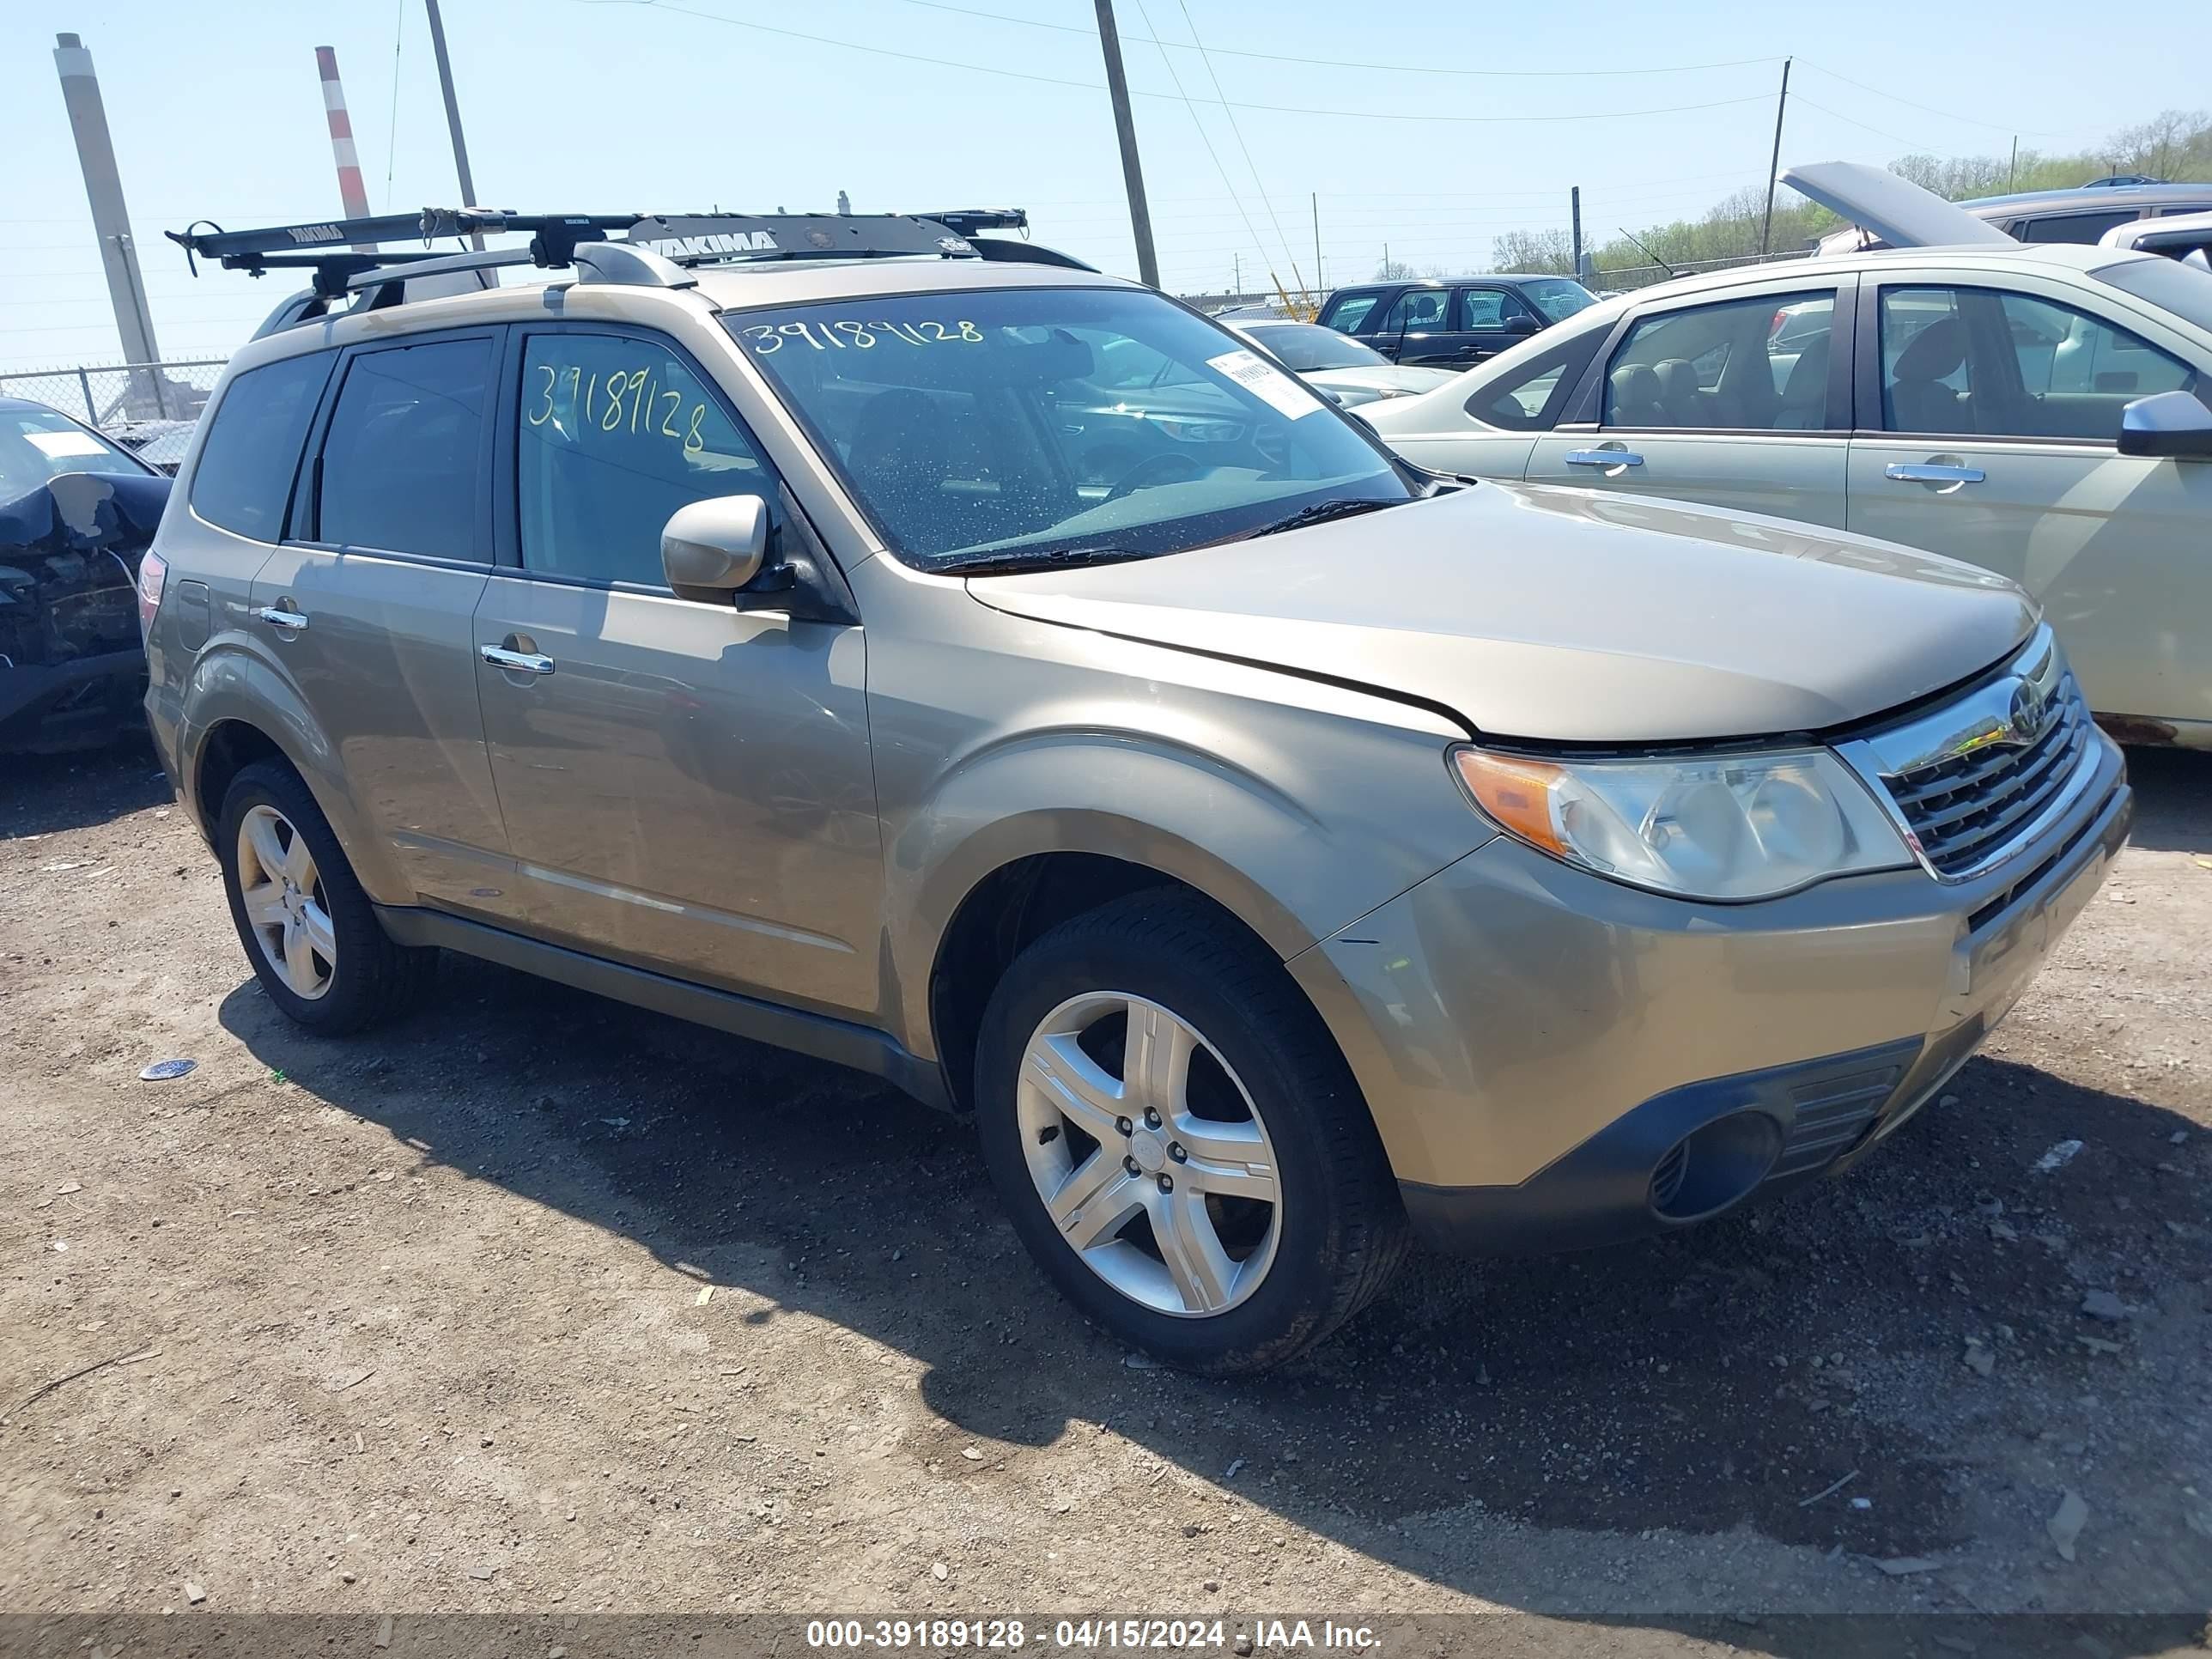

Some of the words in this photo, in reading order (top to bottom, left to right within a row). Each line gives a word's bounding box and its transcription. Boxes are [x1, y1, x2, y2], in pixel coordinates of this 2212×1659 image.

[287, 224, 344, 243] YAKIMA
[634, 231, 778, 258] YAKIMA
[742, 320, 984, 354] 39189128
[528, 365, 706, 453] 39189128
